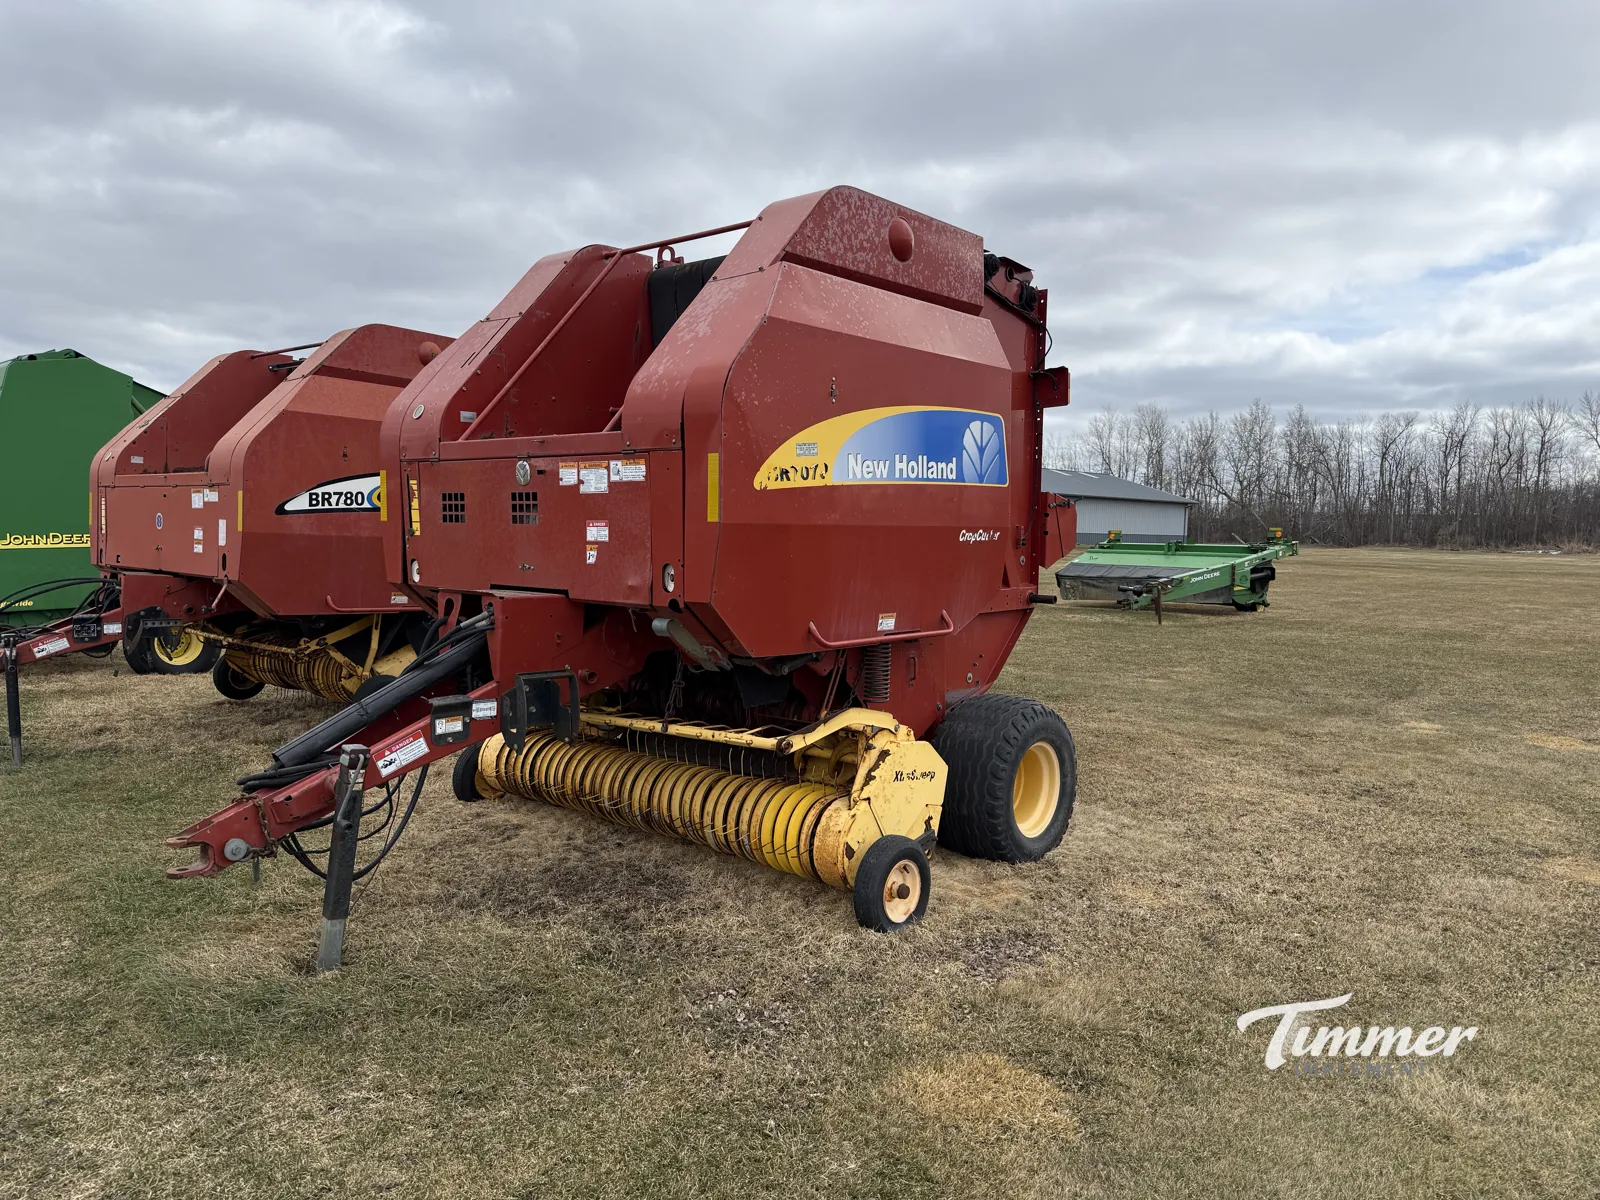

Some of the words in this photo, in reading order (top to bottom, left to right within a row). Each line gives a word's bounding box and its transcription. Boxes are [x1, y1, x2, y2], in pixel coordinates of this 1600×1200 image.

[847, 453, 888, 479] New
[894, 454, 957, 480] Holland
[308, 491, 365, 507] BR780
[1, 532, 47, 546] JOHN
[1190, 575, 1204, 584] JOHN
[1204, 571, 1220, 580] DEERE
[391, 737, 414, 751] DANGER
